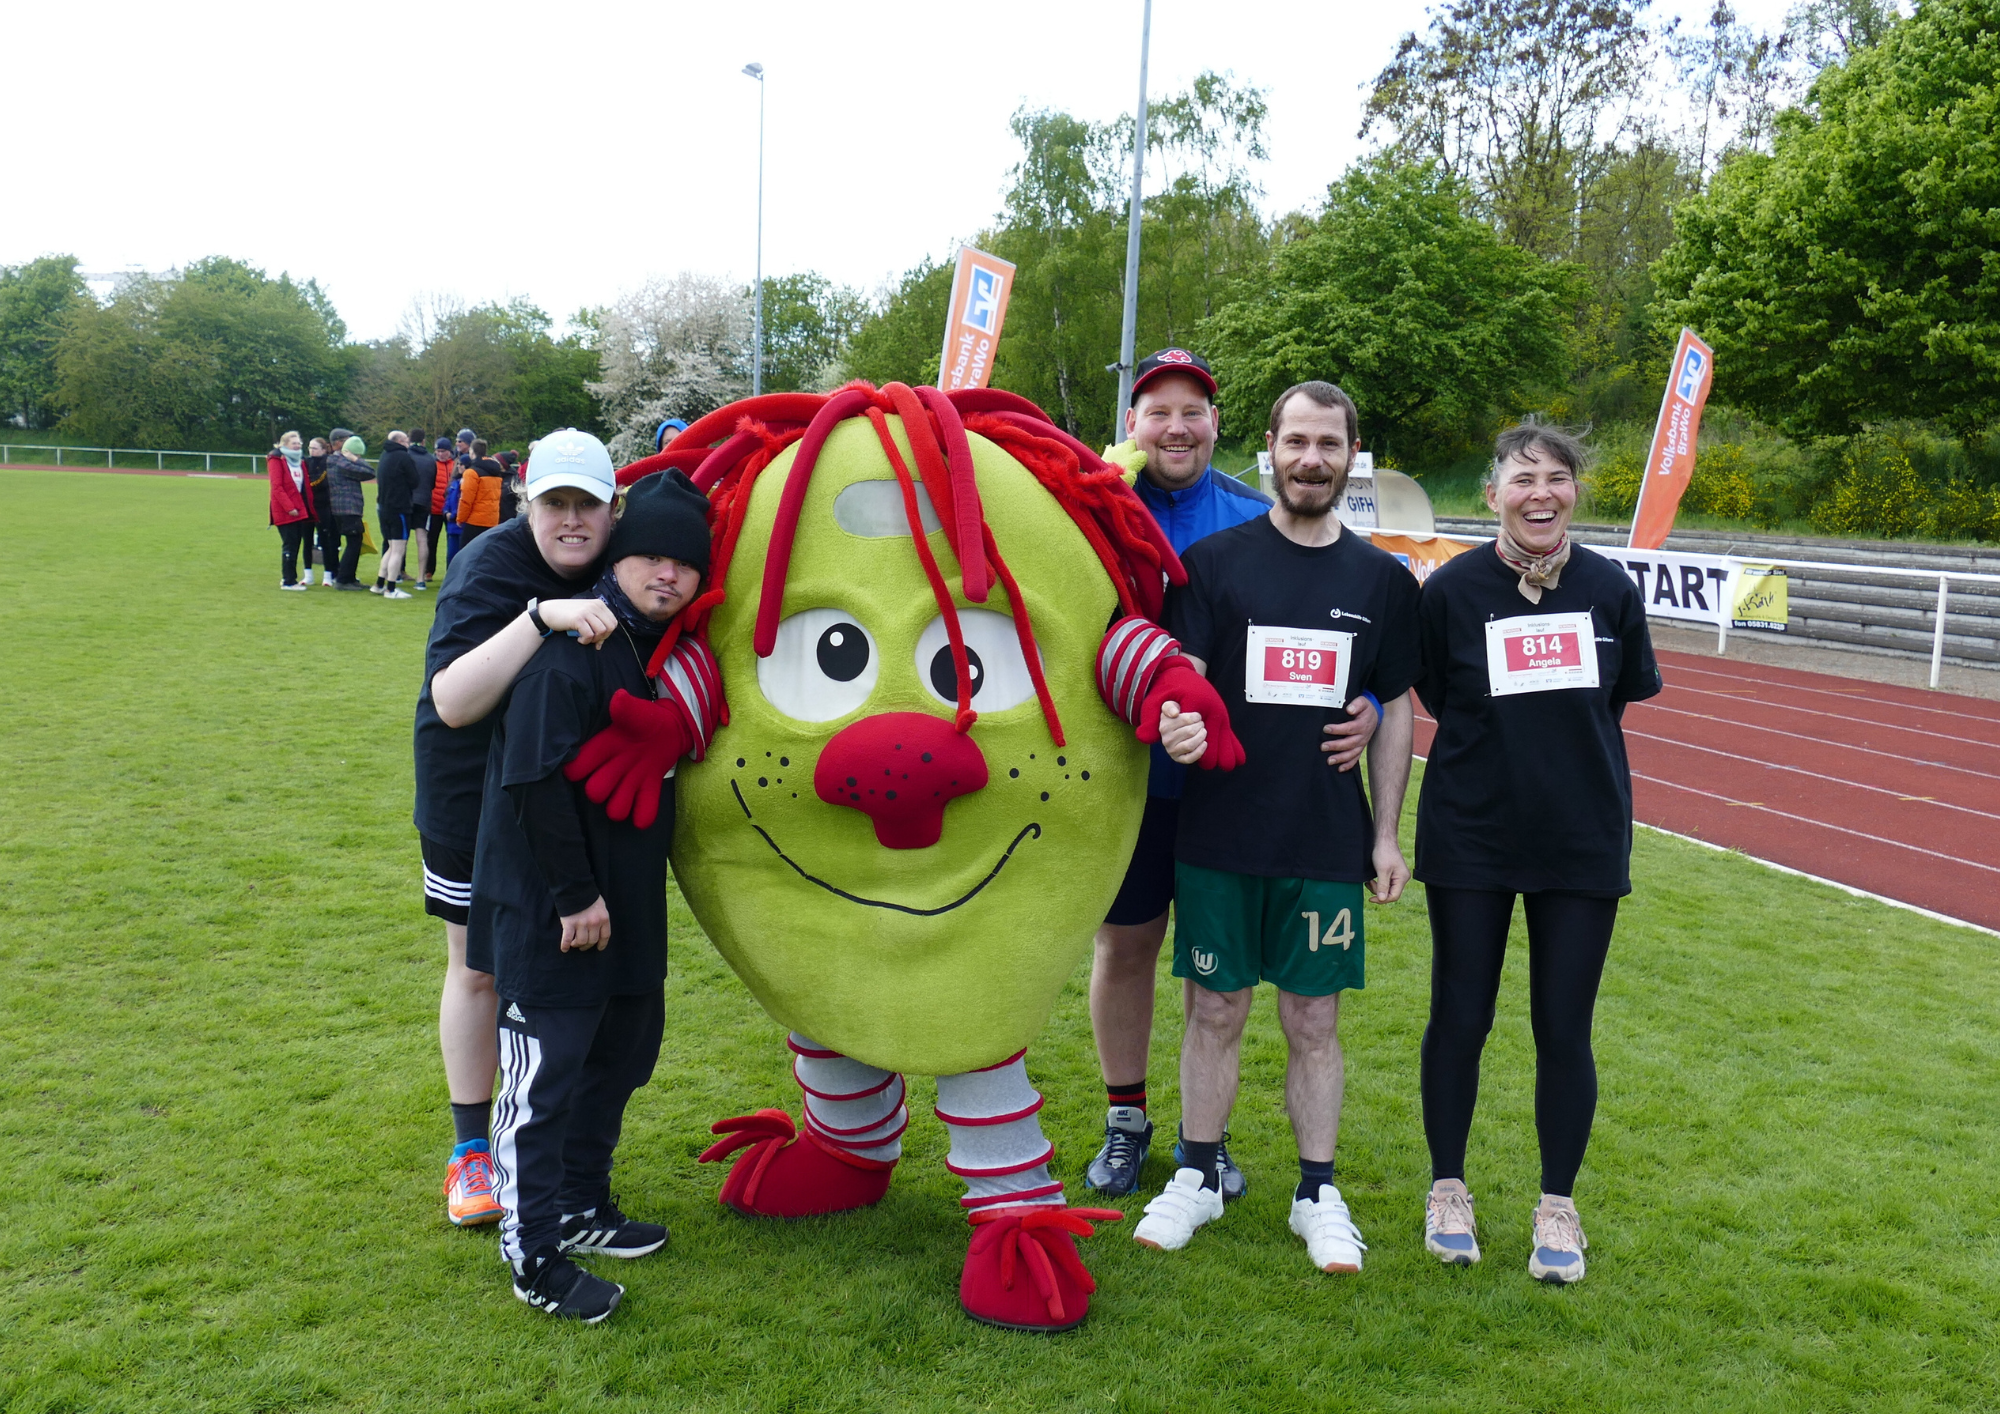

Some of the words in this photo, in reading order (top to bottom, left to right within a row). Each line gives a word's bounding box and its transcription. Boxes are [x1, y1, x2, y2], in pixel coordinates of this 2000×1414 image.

[1658, 402, 1682, 475] Volksbank
[1677, 408, 1691, 456] BraWo
[555, 456, 586, 465] adidas
[1608, 558, 1729, 613] TART
[1522, 635, 1563, 656] 814
[1281, 649, 1321, 670] 819
[1528, 657, 1562, 668] Angela
[1289, 671, 1312, 681] Sven
[1301, 908, 1355, 952] 14
[506, 1011, 527, 1023] adidas
[1117, 1109, 1129, 1117] NIKE
